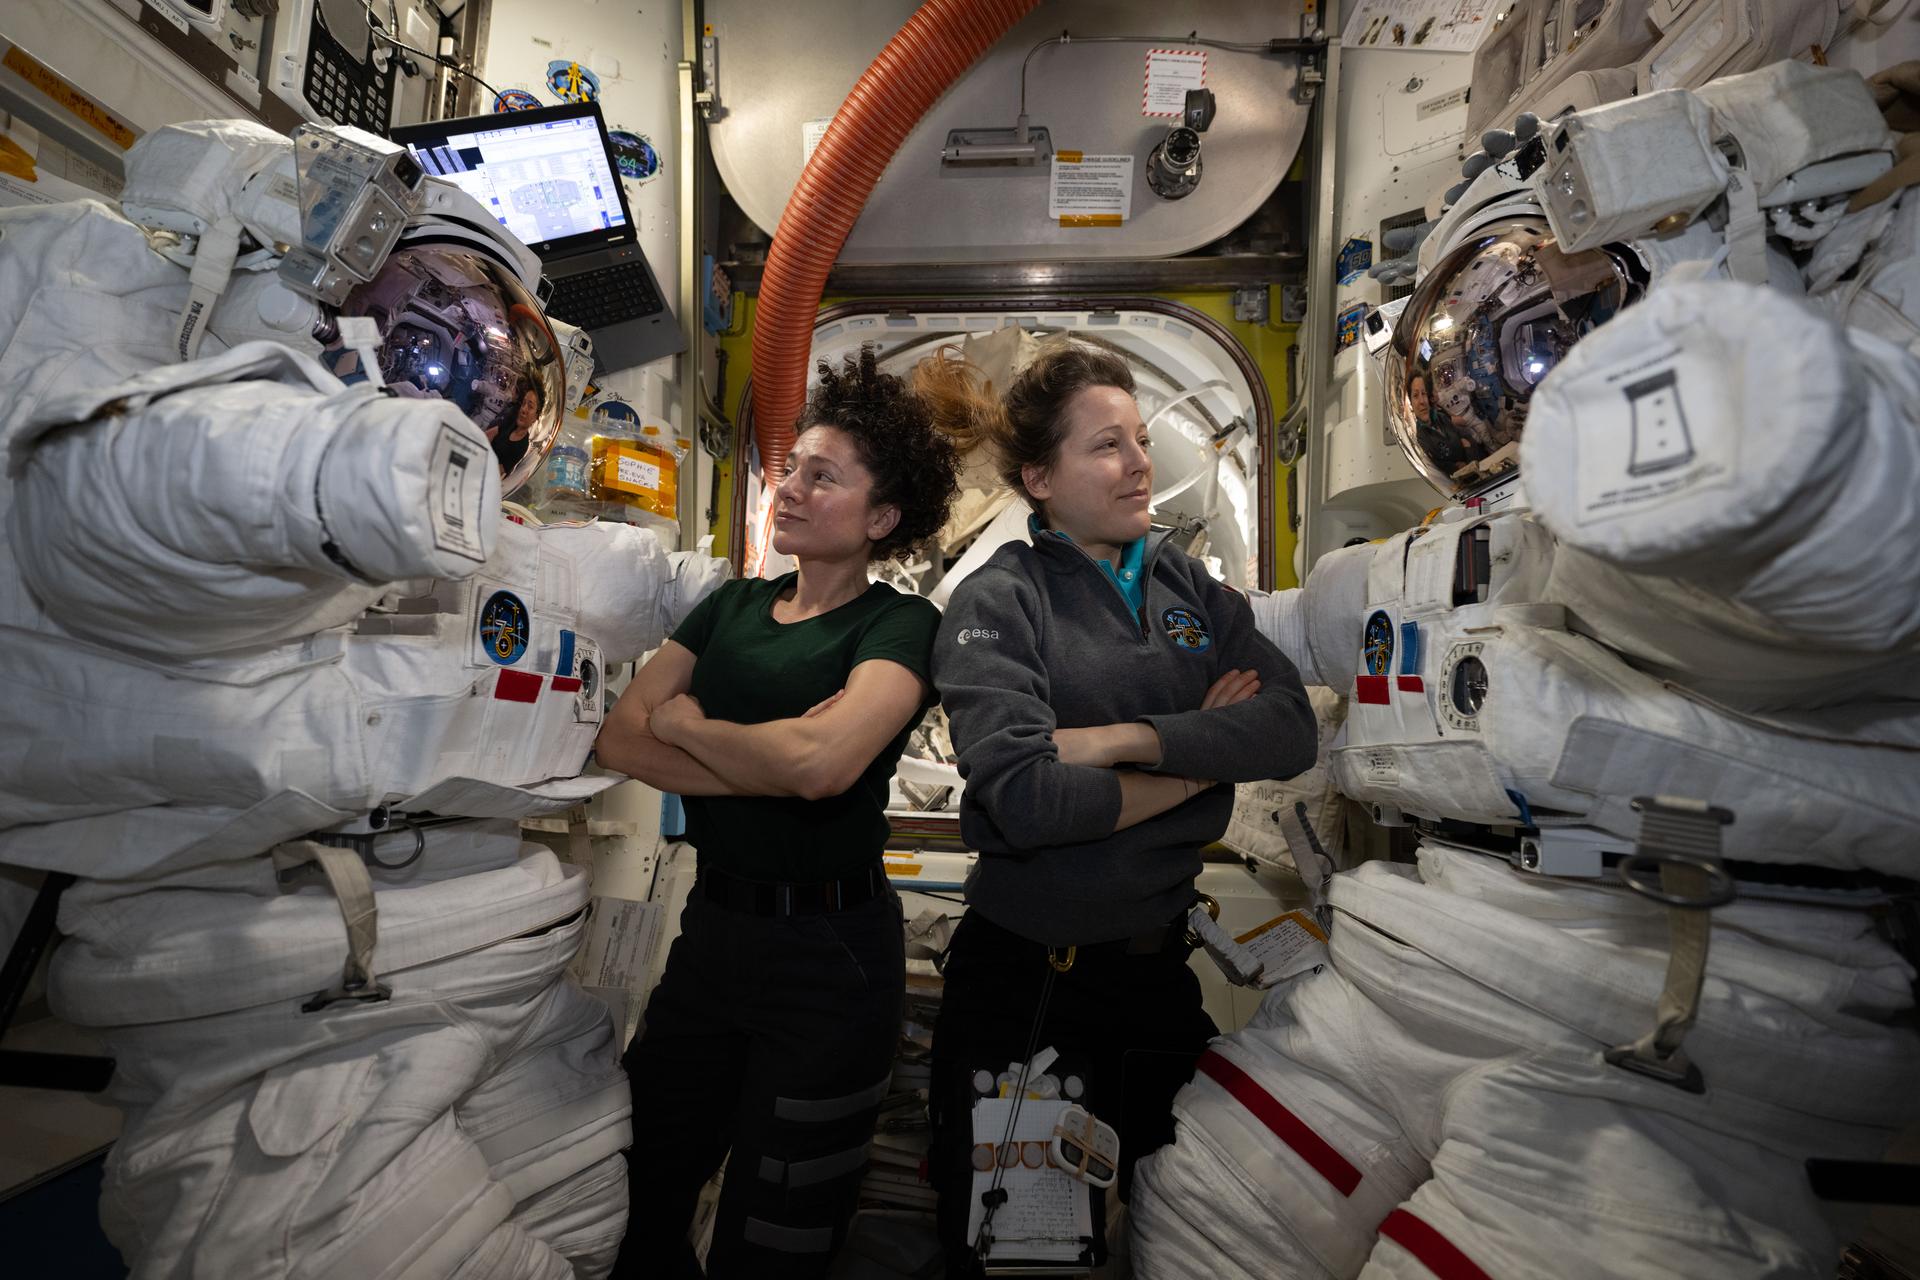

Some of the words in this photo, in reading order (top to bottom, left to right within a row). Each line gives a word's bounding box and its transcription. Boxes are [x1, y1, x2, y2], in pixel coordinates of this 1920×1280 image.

[618, 155, 638, 170] 64
[620, 457, 656, 474] SOPHIE
[619, 474, 656, 490] SNACKS
[495, 620, 514, 658] 75
[972, 628, 1000, 640] esa
[1176, 624, 1200, 649] 75
